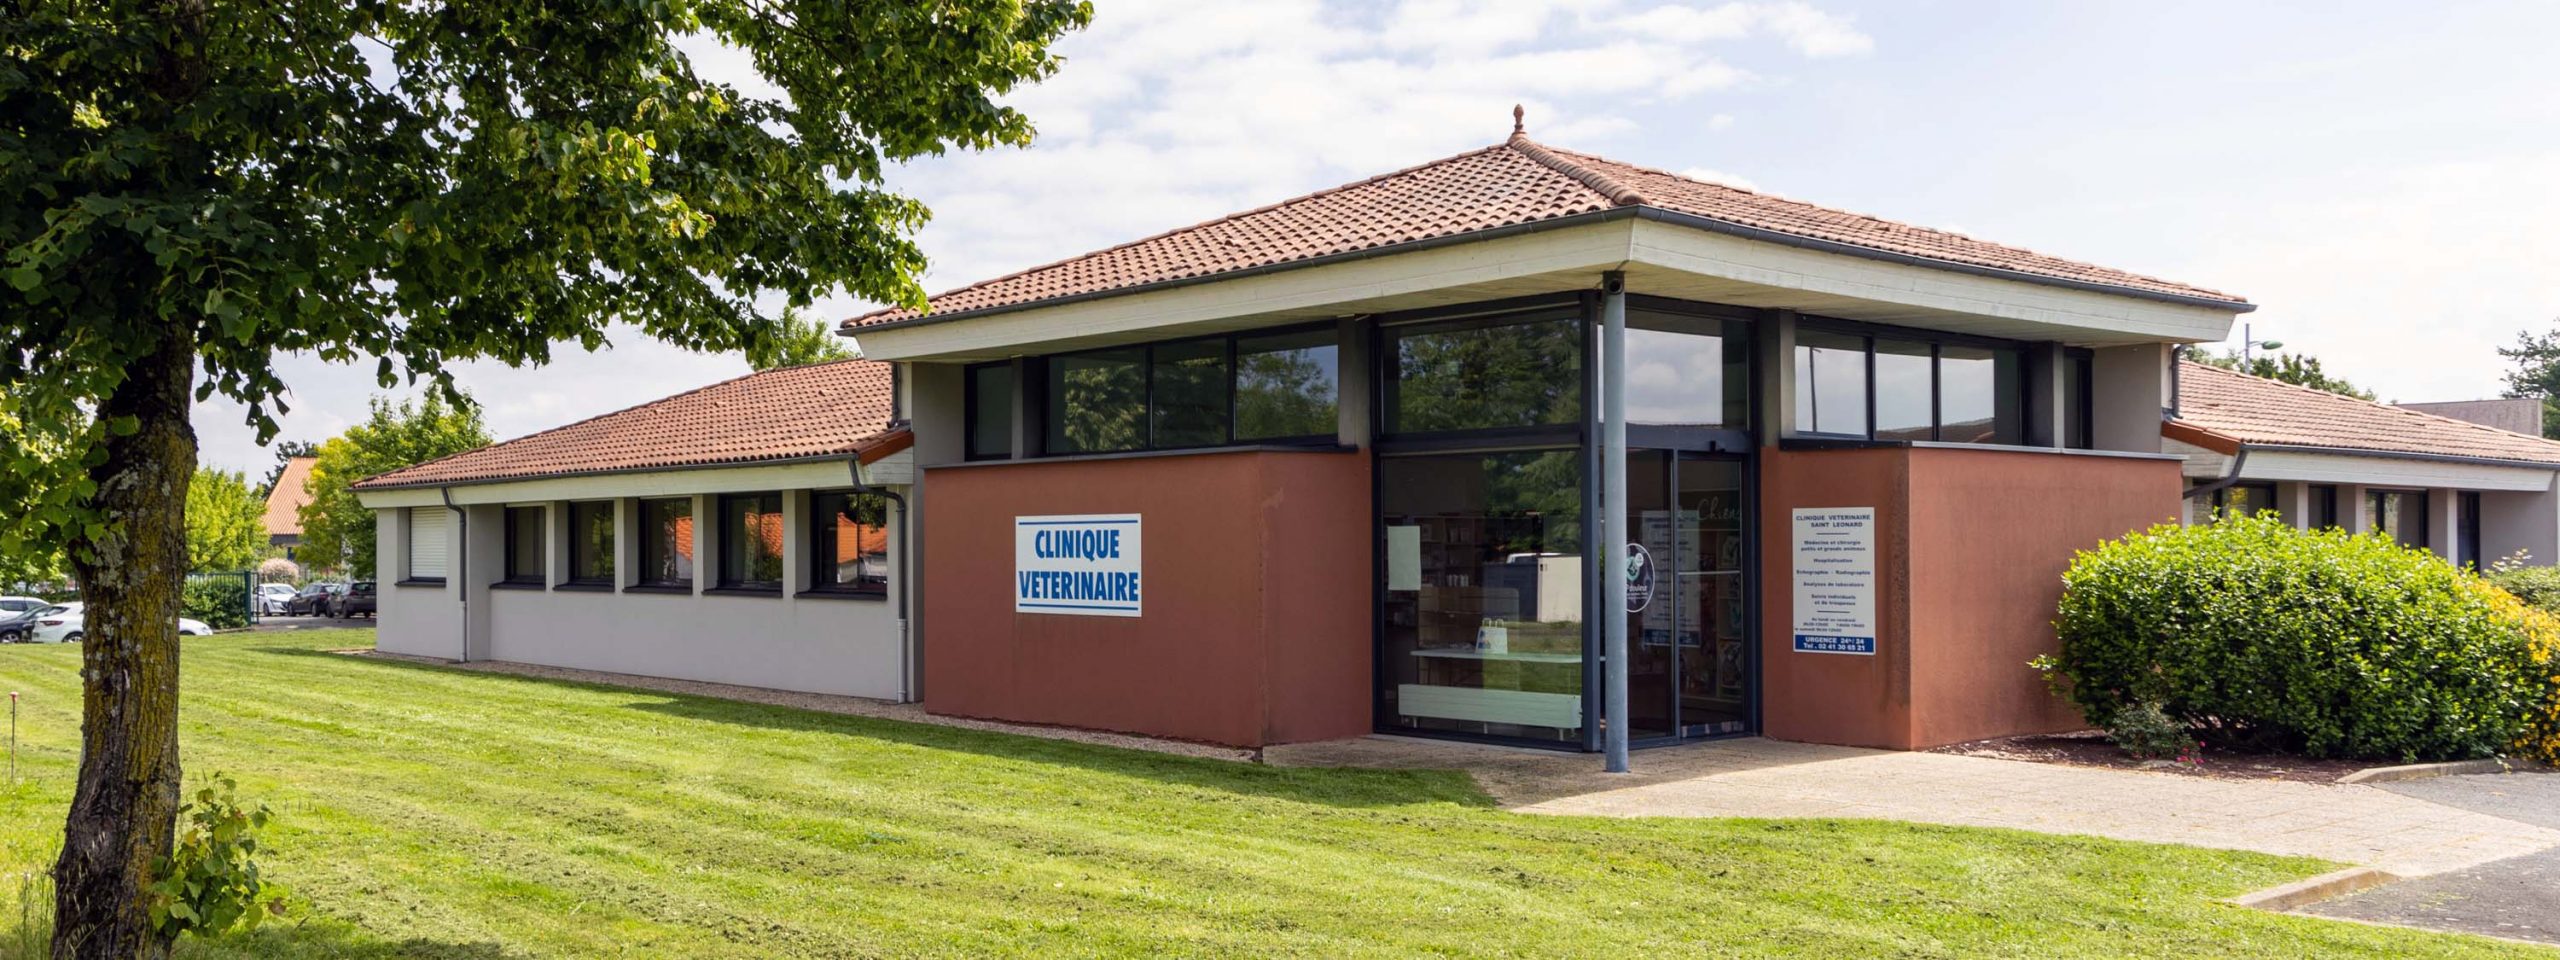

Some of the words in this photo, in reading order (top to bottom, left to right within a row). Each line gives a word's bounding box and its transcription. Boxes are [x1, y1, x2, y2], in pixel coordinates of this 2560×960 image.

[1035, 529, 1120, 562] CLINIQUE
[1018, 571, 1139, 602] VETERINAIRE
[1805, 636, 1838, 644] URGENCE
